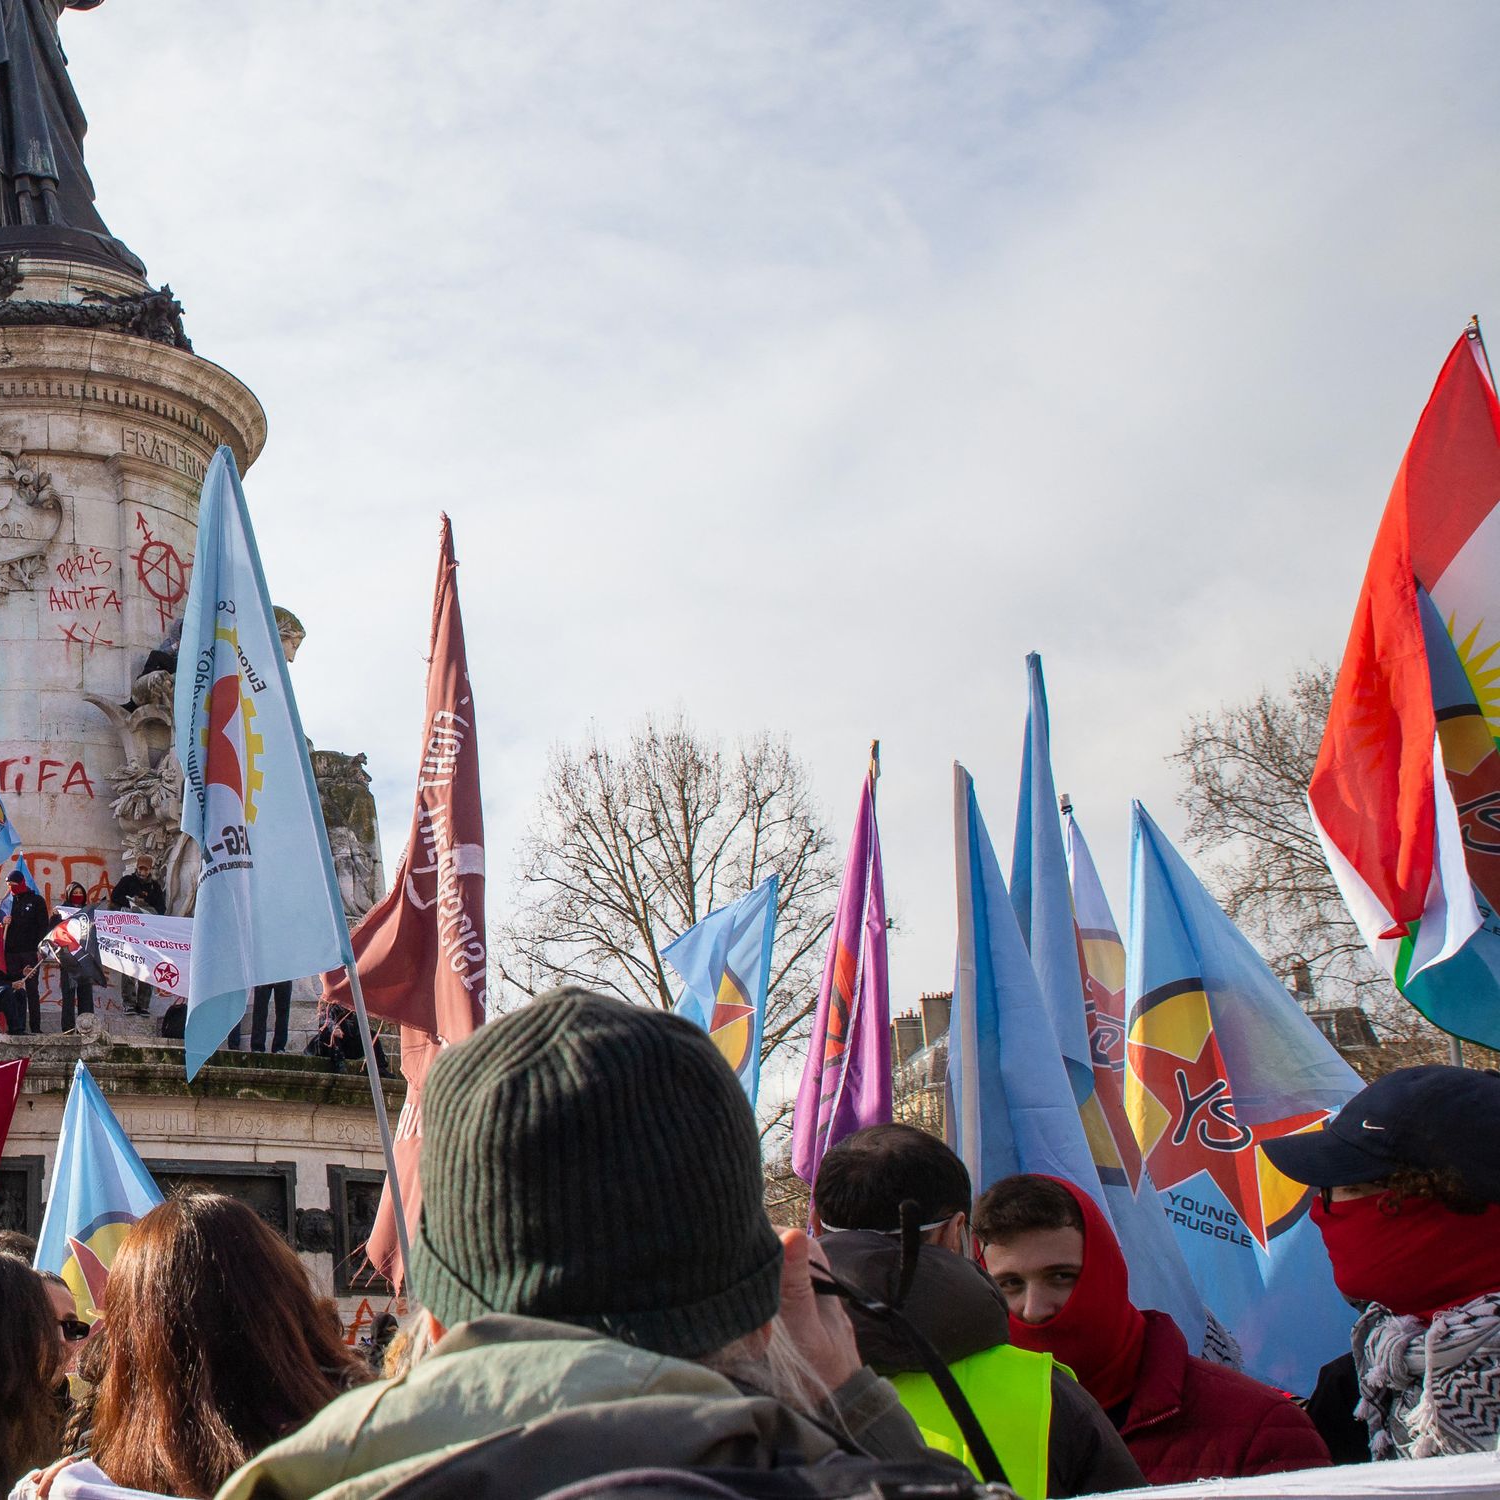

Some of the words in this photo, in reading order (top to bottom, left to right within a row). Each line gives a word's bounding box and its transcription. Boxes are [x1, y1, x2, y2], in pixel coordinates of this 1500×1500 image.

[228, 1116, 266, 1135] 1792
[362, 1125, 380, 1142] SE
[1167, 1191, 1238, 1226] YOUNG
[1163, 1208, 1254, 1250] TRUGGLE
